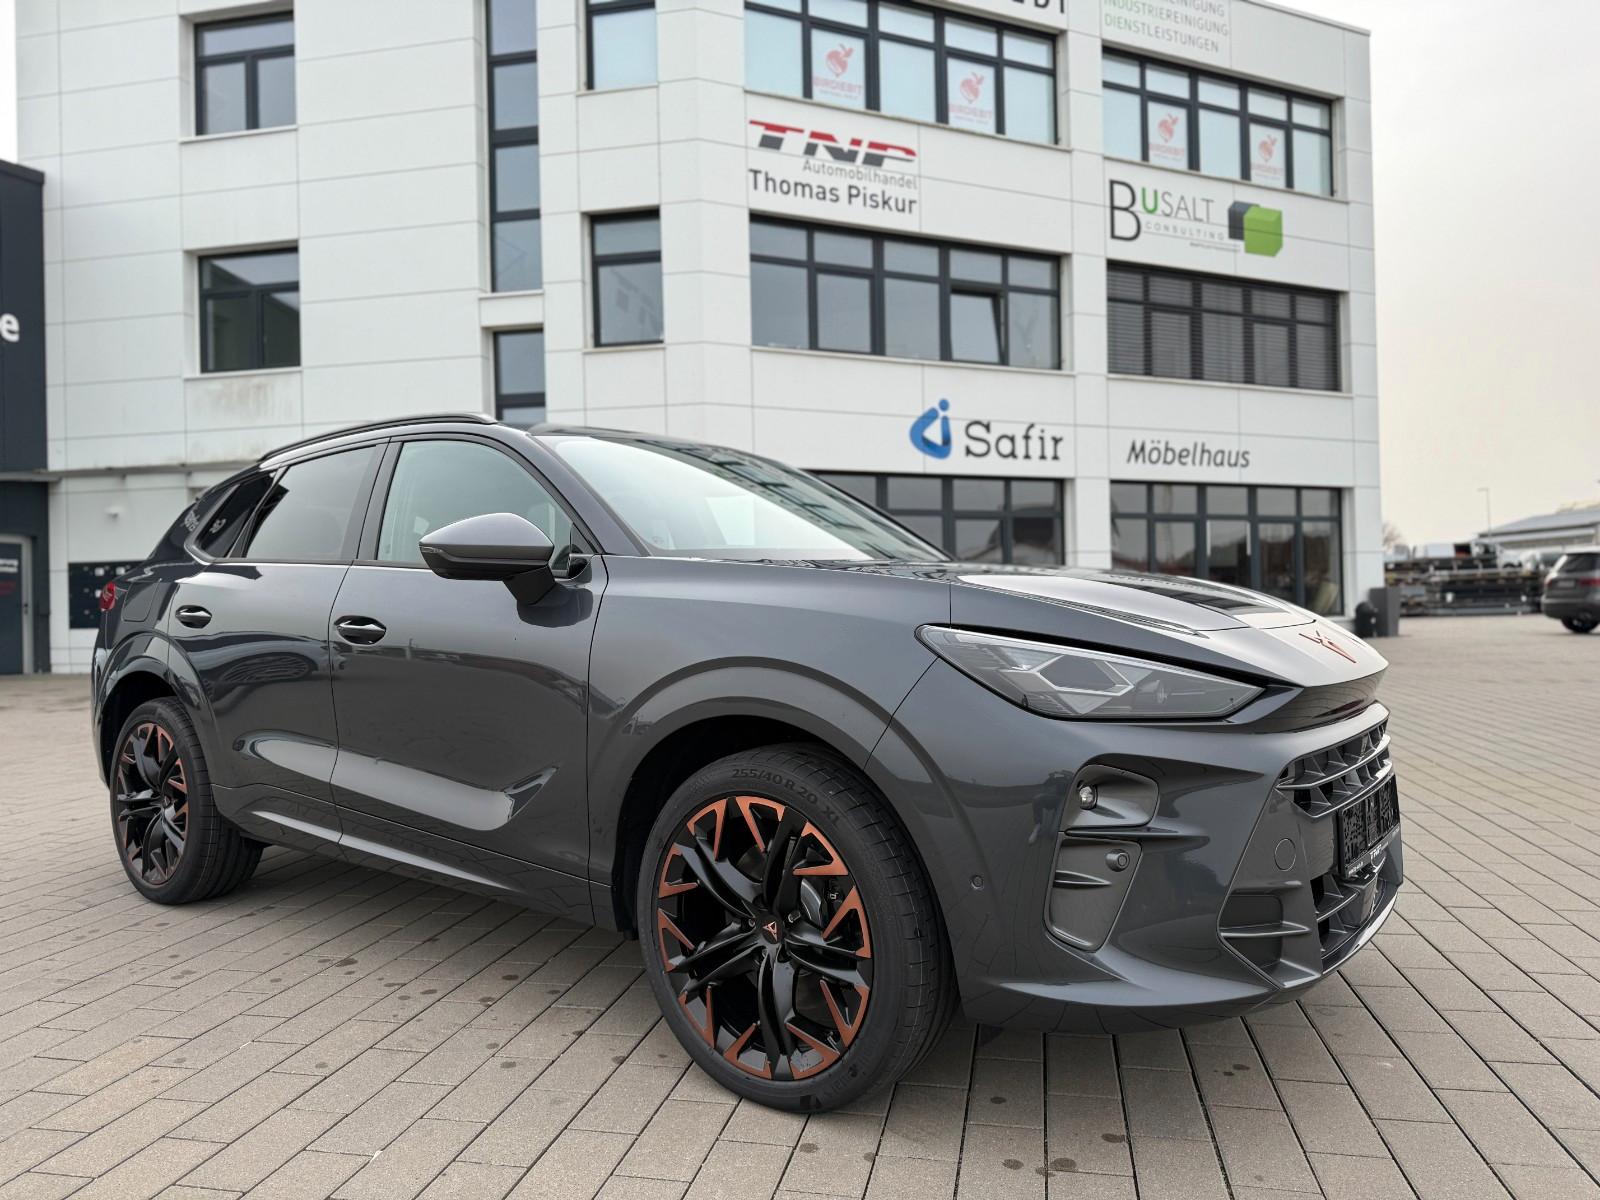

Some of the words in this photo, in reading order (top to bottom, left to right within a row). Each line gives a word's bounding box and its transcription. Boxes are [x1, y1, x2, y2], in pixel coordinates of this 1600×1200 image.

[1104, 13, 1219, 53] DIENSTLEISTUNGEN
[749, 120, 917, 168] TNP
[749, 168, 840, 203] Thomas
[847, 184, 918, 214] Piskur
[802, 159, 918, 190] Automobilhandel
[1109, 179, 1214, 242] BUSALT
[1145, 220, 1226, 242] CONSULTING
[964, 420, 1064, 462] Safir
[1126, 439, 1251, 469] Möbelhaus
[732, 768, 784, 786] 255/40
[798, 786, 819, 805] 20
